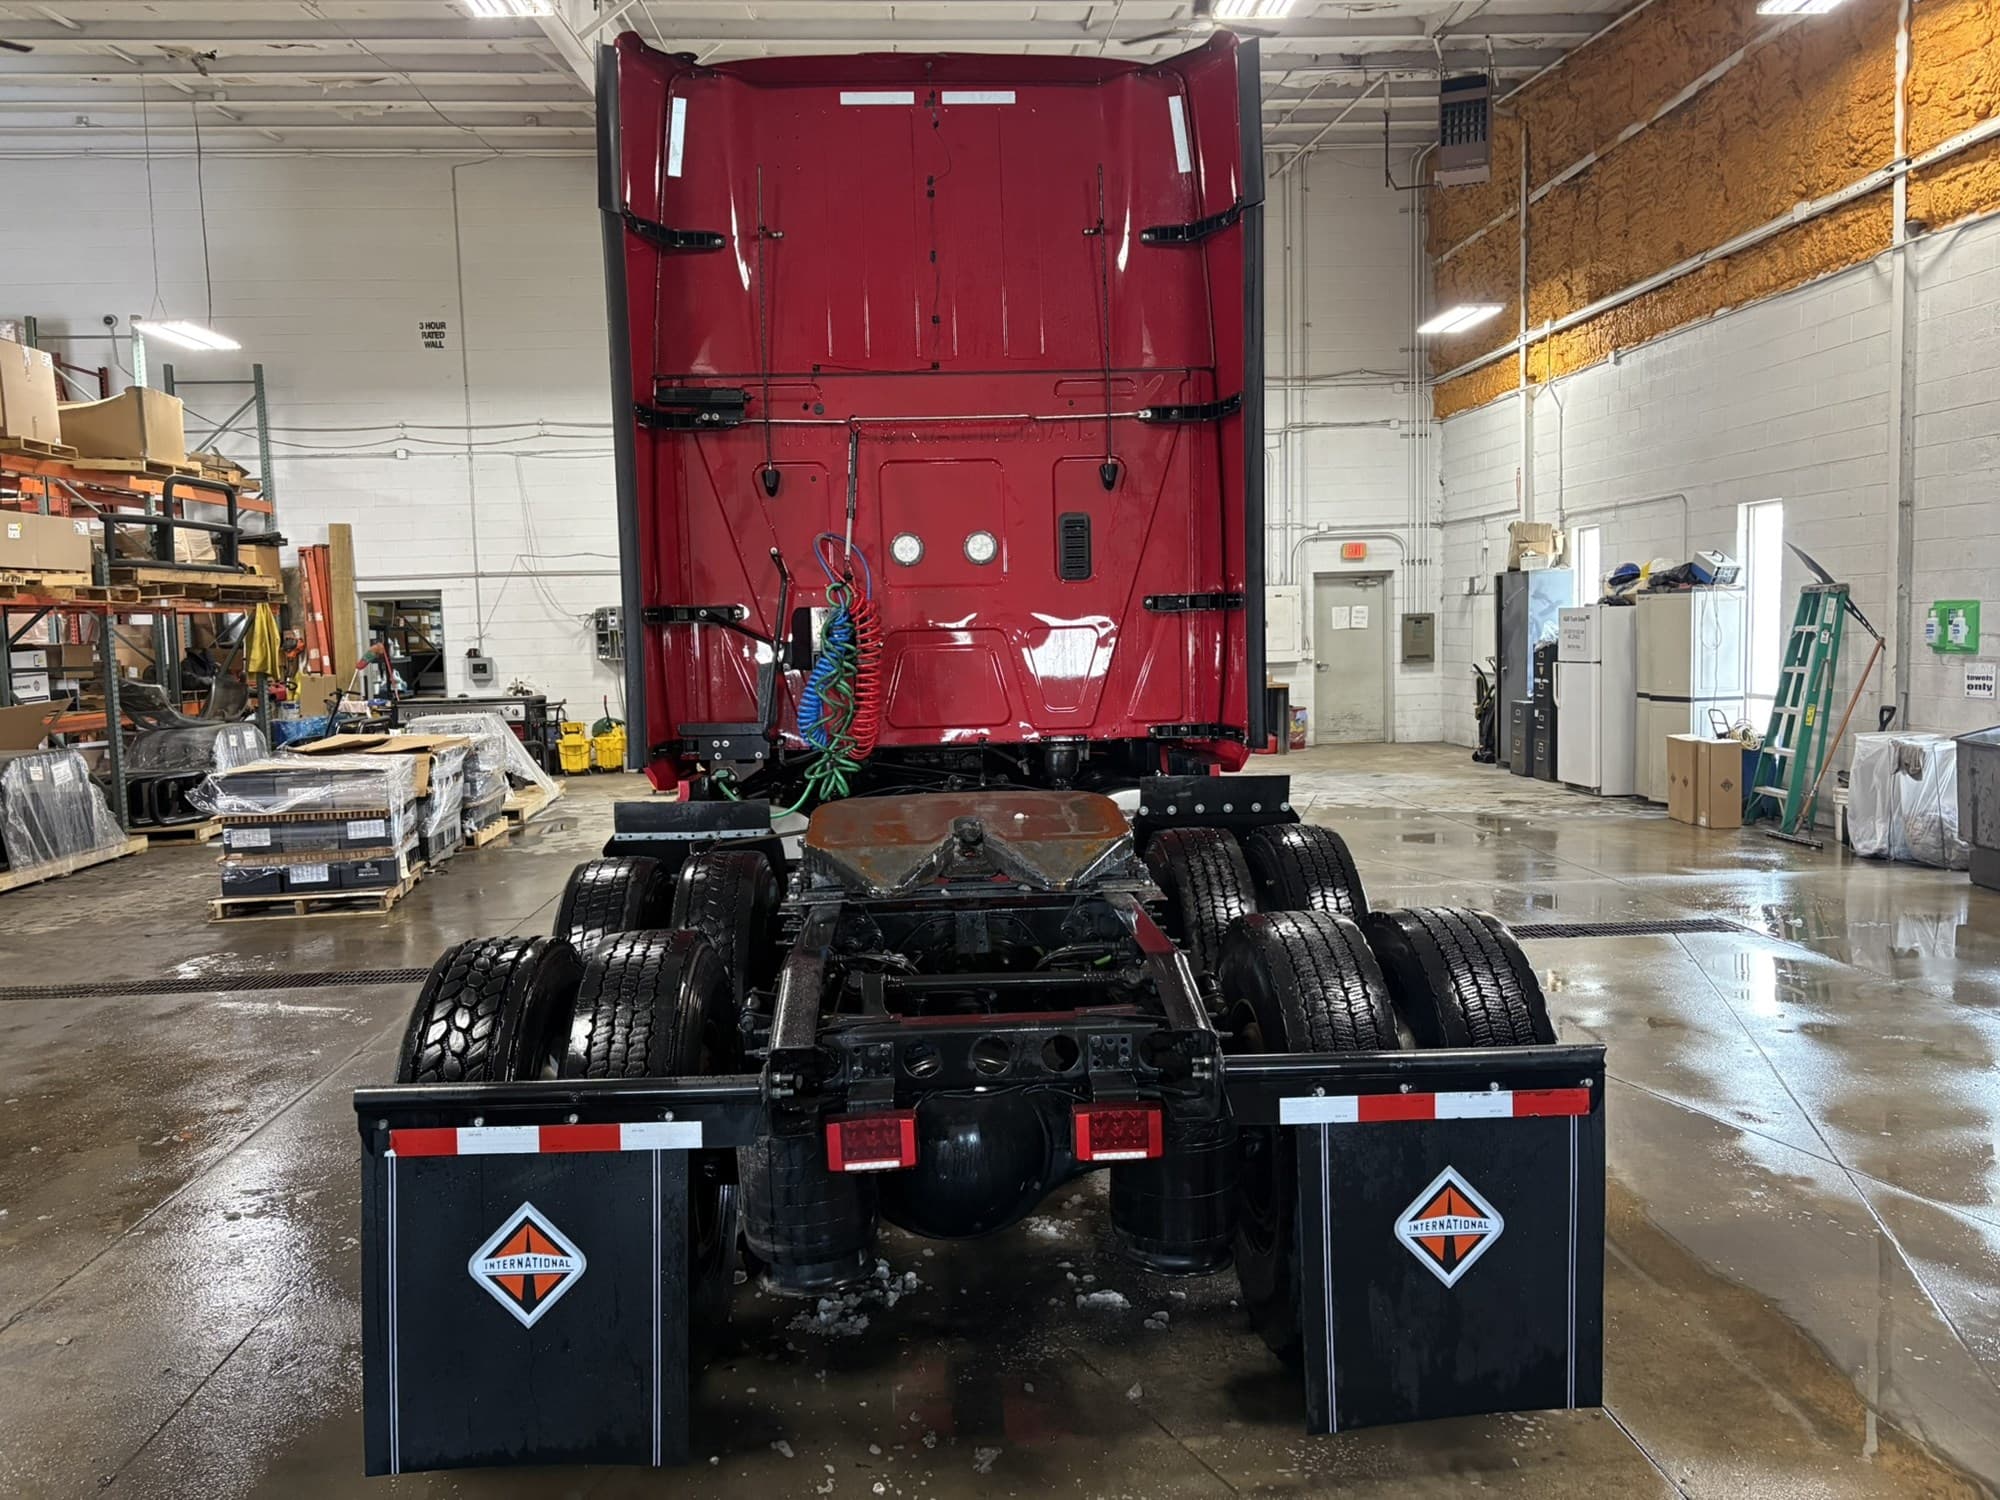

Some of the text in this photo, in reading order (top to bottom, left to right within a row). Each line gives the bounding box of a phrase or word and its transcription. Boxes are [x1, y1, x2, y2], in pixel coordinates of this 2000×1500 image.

[419, 321, 446, 330] 3 HOUR
[421, 331, 445, 339] RATED
[424, 340, 444, 348] WALL
[1967, 683, 1993, 692] only
[1409, 1219, 1489, 1232] INTERNATIONAL
[484, 1257, 571, 1270] INTERNATIONAL
